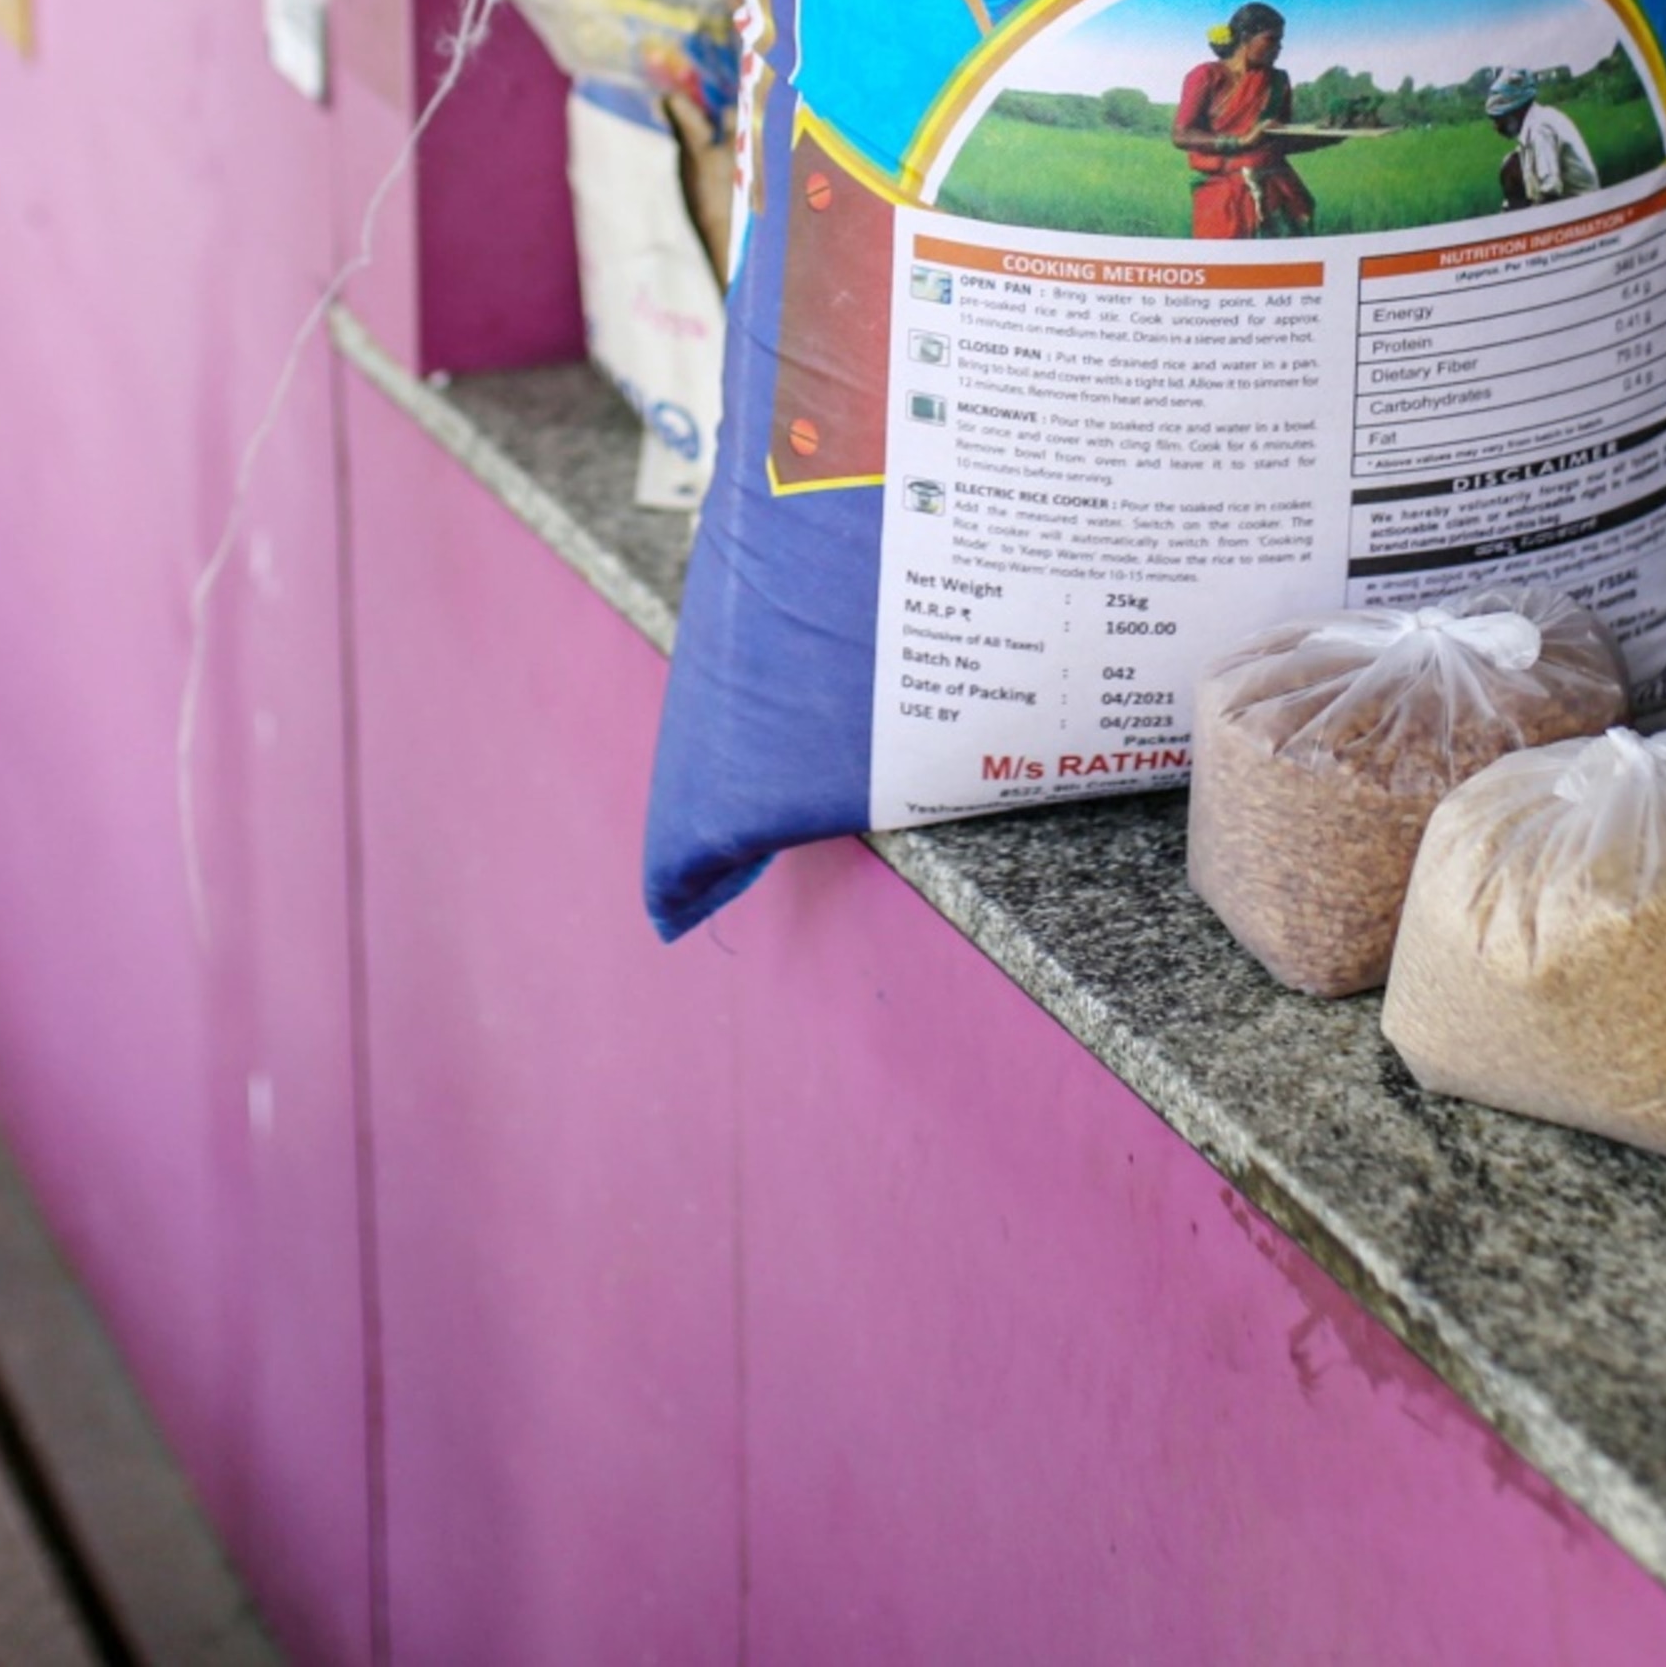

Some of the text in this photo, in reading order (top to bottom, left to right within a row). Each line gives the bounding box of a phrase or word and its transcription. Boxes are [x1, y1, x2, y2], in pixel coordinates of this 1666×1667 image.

[1440, 215, 1625, 267] NUTRITION INFORMATION
[1003, 253, 1207, 285] COOKING METHODS
[1505, 261, 1521, 273] Per
[961, 273, 995, 291] OPEN
[1005, 280, 1031, 296] PAN
[1053, 286, 1086, 306] Bring
[1096, 293, 1132, 306] water
[1164, 294, 1210, 311] boiling
[1220, 296, 1255, 311] point.
[1265, 293, 1292, 308] Add
[1300, 294, 1321, 307] the
[1373, 305, 1434, 323] Energy
[1637, 248, 1659, 266] kcal
[960, 296, 1026, 315] pre-soaked
[1035, 305, 1057, 318] rice
[1065, 309, 1090, 321] and
[1099, 311, 1119, 323] stir.
[1130, 311, 1163, 325] Cook
[1172, 313, 1239, 328] uncovered
[1248, 313, 1266, 327] for
[958, 338, 1008, 357] CLOSED
[1014, 345, 1041, 361] PAN
[1056, 350, 1076, 365] Put
[1083, 354, 1103, 367] the
[1109, 356, 1158, 371] drained
[1163, 359, 1186, 371] rice
[1192, 359, 1216, 372] and
[1221, 360, 1257, 371] water
[1293, 358, 1318, 372] pan.
[1372, 337, 1433, 354] Protein
[1372, 360, 1431, 383] Dietary
[1437, 357, 1478, 375] Fiber
[975, 379, 1024, 397] minutes.
[1028, 384, 1077, 402] Remove
[1080, 389, 1110, 404] from
[1113, 392, 1141, 406] heat
[1143, 395, 1168, 408] and
[1170, 397, 1205, 409] serve.
[1369, 387, 1492, 415] Carbohydrates
[957, 401, 1037, 424] MICROWAVE
[1051, 413, 1080, 428] Pour
[1085, 417, 1106, 430] the
[1110, 420, 1154, 433] soaked
[1158, 421, 1181, 434] rice
[1186, 421, 1211, 435] and
[1215, 423, 1250, 435] water
[1284, 419, 1316, 433] bowl.
[1369, 431, 1397, 446] Fat
[1375, 458, 1411, 469] Above
[1455, 448, 1477, 459] may
[1482, 443, 1503, 454] vary
[1507, 436, 1531, 449] from
[1453, 440, 1618, 494] DISCLAIMER
[954, 481, 1015, 501] ELECTRIC
[1019, 490, 1048, 506] RICE
[1052, 493, 1108, 510] COOKER
[1121, 498, 1149, 513] Pour
[1155, 501, 1175, 513] the
[1180, 501, 1223, 514] soaked
[1227, 502, 1250, 513] rice
[1270, 499, 1312, 512] cooker.
[1401, 505, 1450, 521] hereby
[1458, 489, 1531, 513] voluntarily
[1539, 478, 1579, 496] forego
[1612, 460, 1625, 476] all
[1371, 521, 1439, 539] actionable
[1445, 514, 1480, 530] claim
[1507, 493, 1575, 519] enforceable
[1581, 483, 1606, 501] right
[1370, 538, 1408, 554] brand
[1411, 535, 1445, 549] name
[1448, 525, 1493, 545] printed
[1515, 518, 1536, 532] this
[1538, 513, 1561, 531] bag
[906, 570, 1148, 611] Net Weight 25kg
[1599, 589, 1636, 609] norms
[905, 599, 956, 619] M.R.P
[1106, 621, 1176, 636] 1600.00
[903, 624, 963, 644] (Inclusive
[983, 636, 1001, 648] All
[1004, 639, 1045, 654] Taxes)
[902, 647, 951, 667] Batch
[1102, 667, 1135, 681] 042
[901, 675, 942, 695] Date
[969, 684, 1037, 705] Packing
[1101, 692, 1175, 706] 04/2021
[900, 702, 1173, 729] USE BY 04/2023
[981, 749, 1193, 780] M/s RATHN
